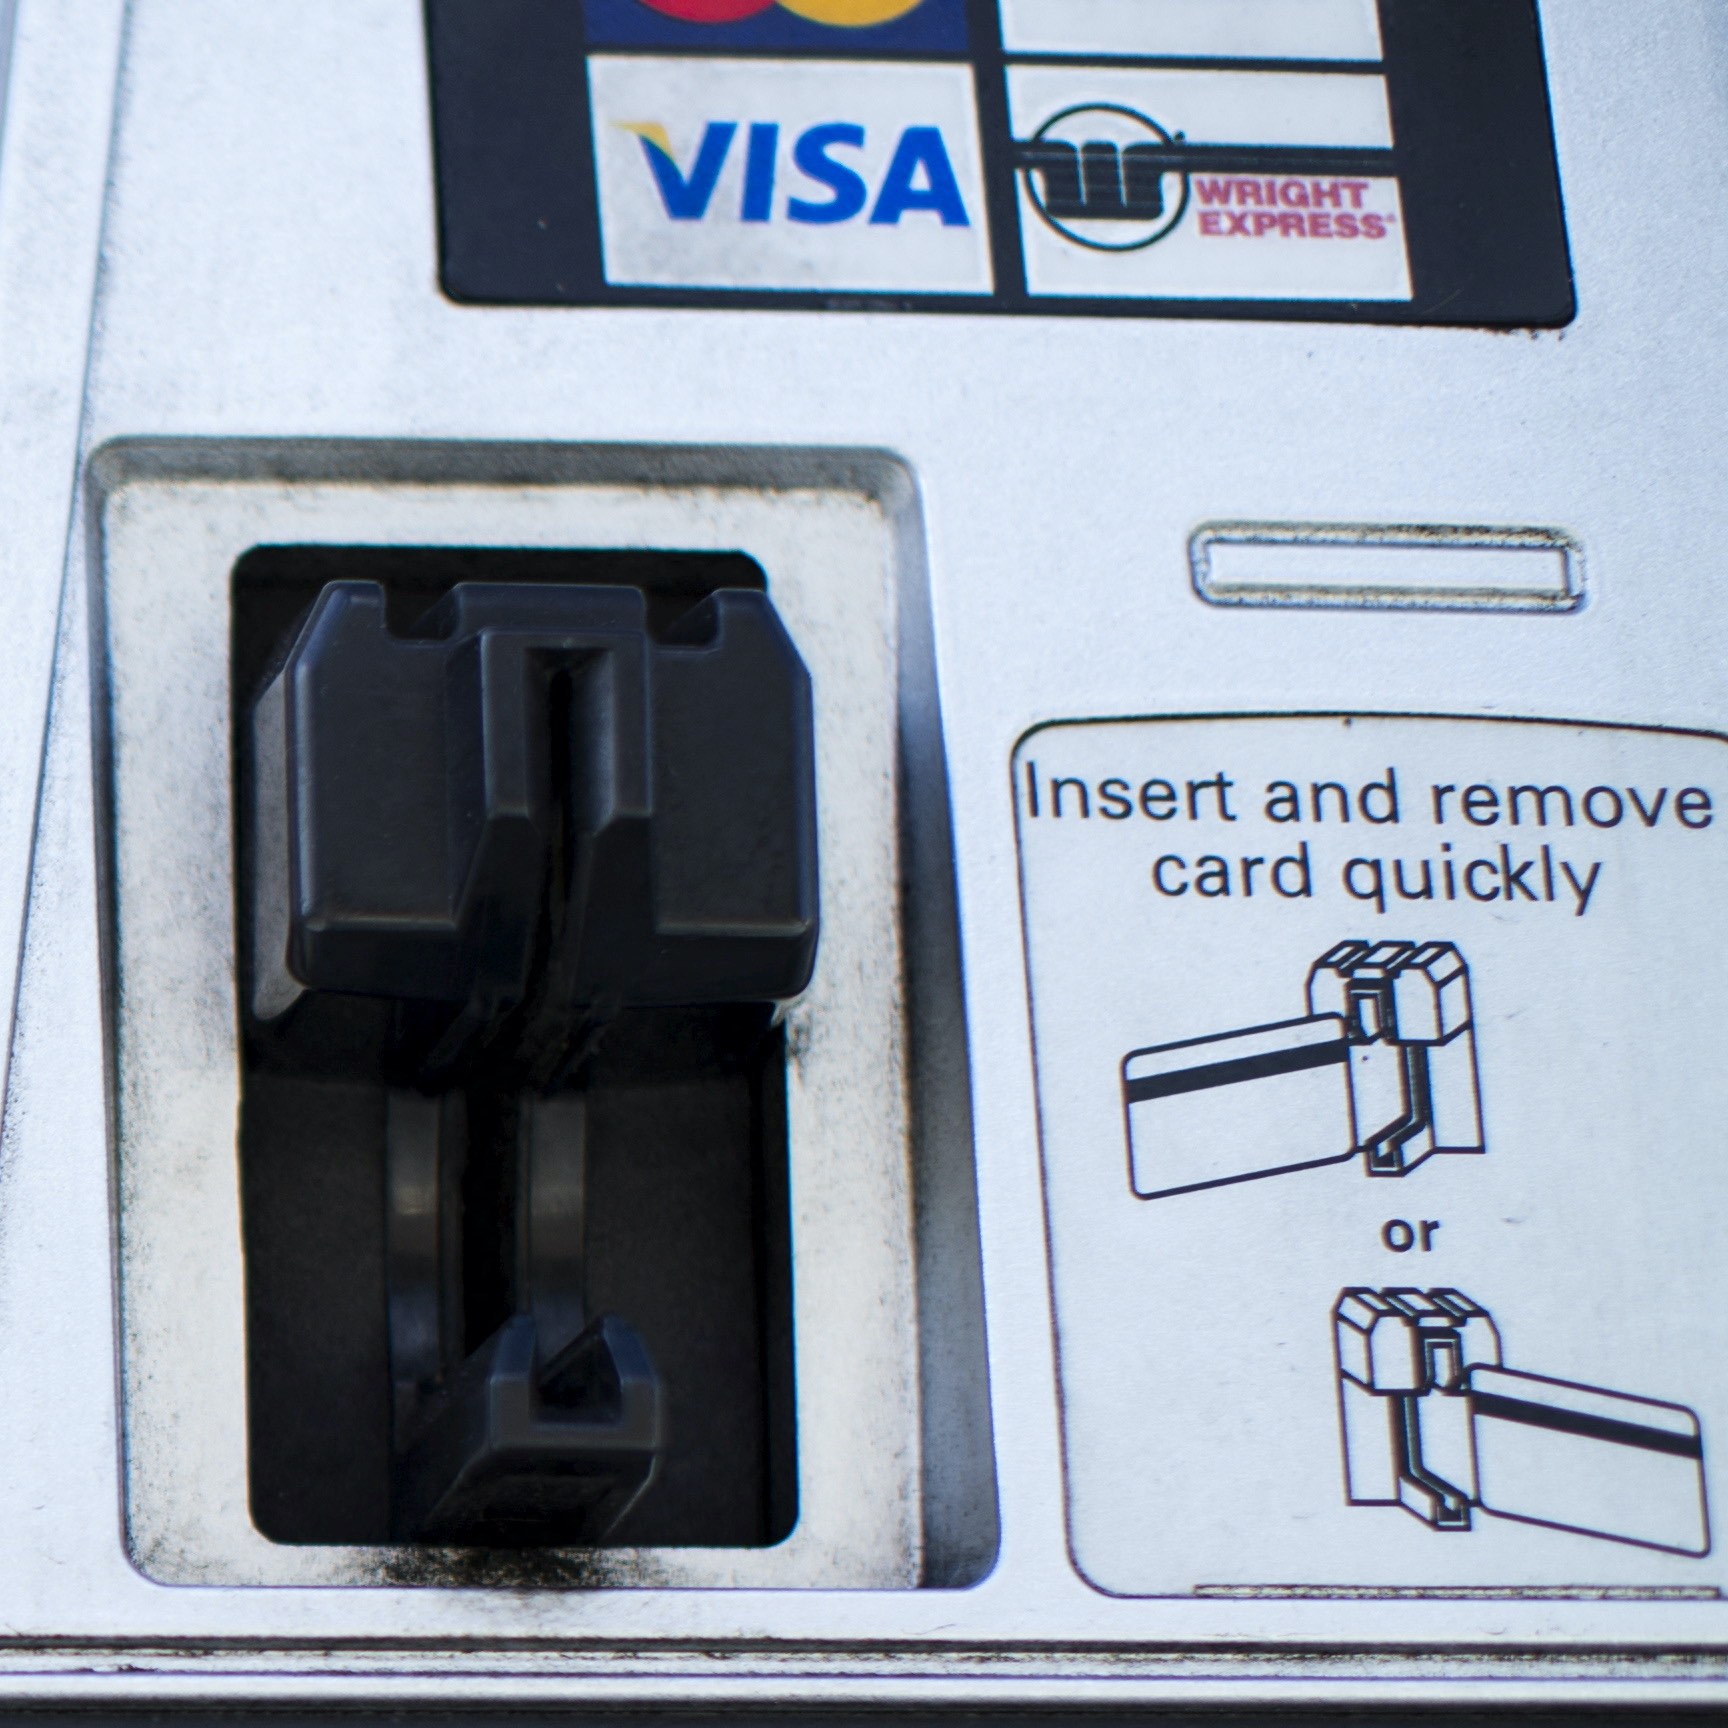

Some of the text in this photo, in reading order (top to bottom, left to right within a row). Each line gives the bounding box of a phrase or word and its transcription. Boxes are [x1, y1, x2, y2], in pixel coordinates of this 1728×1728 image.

[614, 122, 970, 227] VISA
[1196, 178, 1369, 209] WRIGHT
[1027, 761, 1713, 829] Insert and remove
[1153, 841, 1601, 916] card quickly
[1382, 1219, 1439, 1252] or
